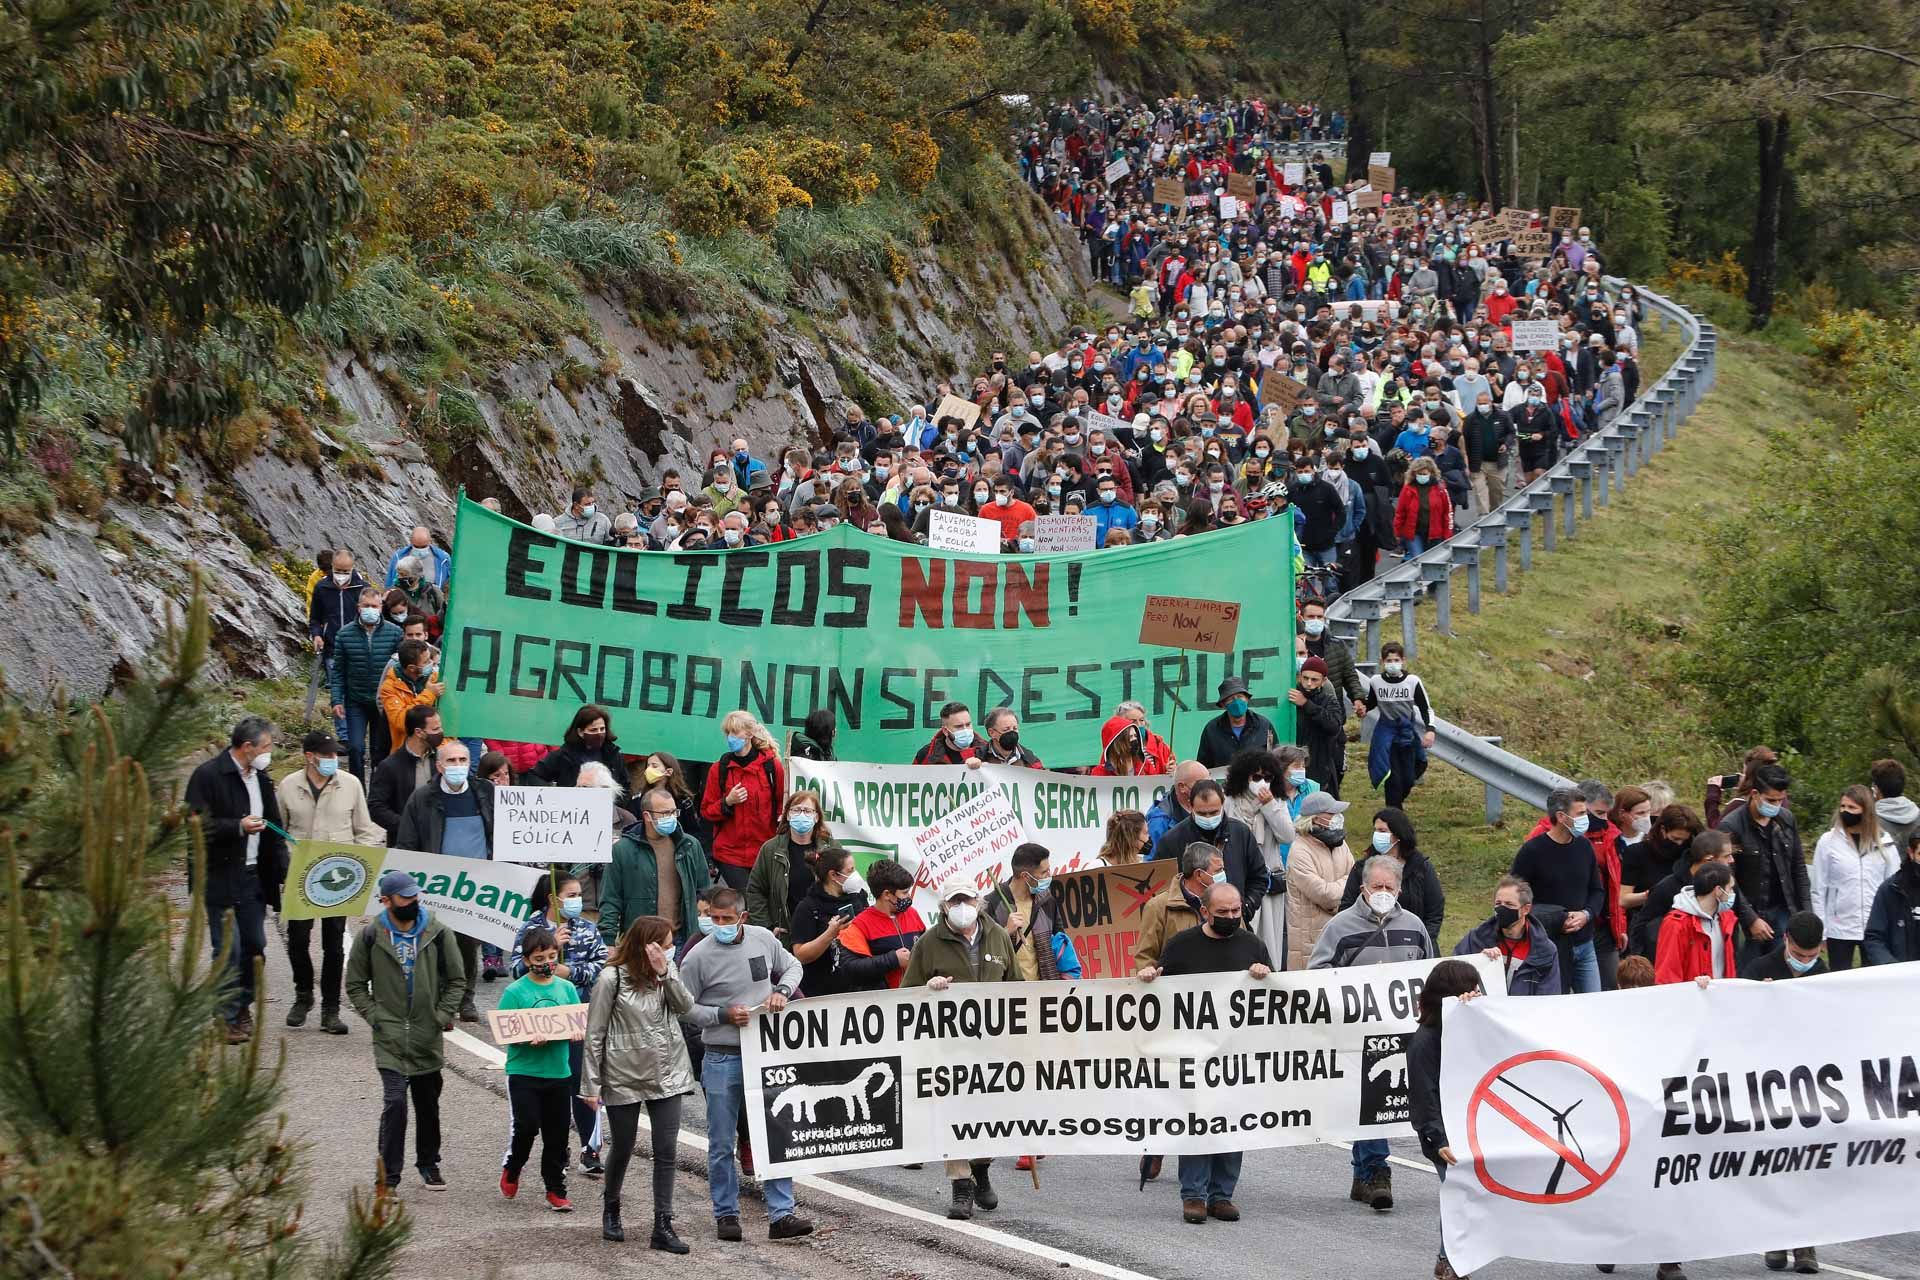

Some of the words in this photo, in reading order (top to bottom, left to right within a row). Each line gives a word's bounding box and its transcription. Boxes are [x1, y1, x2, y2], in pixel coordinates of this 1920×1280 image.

[933, 512, 977, 528] SALVEMOS
[1038, 517, 1093, 527] DESMONTEMOS
[933, 534, 942, 542] DA
[947, 526, 977, 537] GROBA
[505, 528, 872, 628] EOLICOS
[898, 556, 1051, 629] NON
[1147, 611, 1169, 622] PERO
[1172, 612, 1201, 629] NON
[456, 627, 502, 694] A
[510, 633, 723, 719] GROBA
[739, 660, 864, 730] NON
[880, 666, 960, 730] SE
[977, 646, 1280, 724] DESTRUE
[500, 790, 525, 806] NON
[1034, 782, 1100, 830] SERRA
[504, 808, 590, 825] PANDEMIA
[970, 808, 997, 829] NON
[915, 825, 941, 846] NON
[945, 818, 954, 828] A
[990, 826, 1020, 853] NON
[929, 860, 938, 871] A
[1050, 873, 1112, 929] ROBA
[1105, 931, 1140, 979] VE
[759, 1007, 829, 1052] NON
[840, 1004, 885, 1046] AO
[896, 998, 1028, 1042] PARQUE
[1039, 987, 1160, 1034] EÓLICO
[1173, 991, 1219, 1031] NA
[1229, 988, 1332, 1029] SERRA
[1341, 983, 1383, 1024] DA
[1367, 1036, 1401, 1052] SOS
[765, 1066, 797, 1086] SOS
[916, 1060, 1026, 1099] ESPAZO
[1035, 1057, 1169, 1091] NATURAL
[1179, 1058, 1195, 1089] E
[1204, 1048, 1344, 1087] CULTURAL
[1661, 1059, 1850, 1138] EÓLICOS
[951, 1108, 1312, 1141] www.sosgroba.com
[1376, 1110, 1395, 1122] NON
[844, 1122, 885, 1138] Groba
[785, 1146, 804, 1159] NON
[805, 1145, 817, 1157] AO
[819, 1140, 859, 1154] PARQUE
[1653, 1153, 1700, 1188] POR
[1709, 1150, 1746, 1180] UN
[1749, 1143, 1838, 1177] MONTE
[1847, 1138, 1906, 1167] VIVO,
